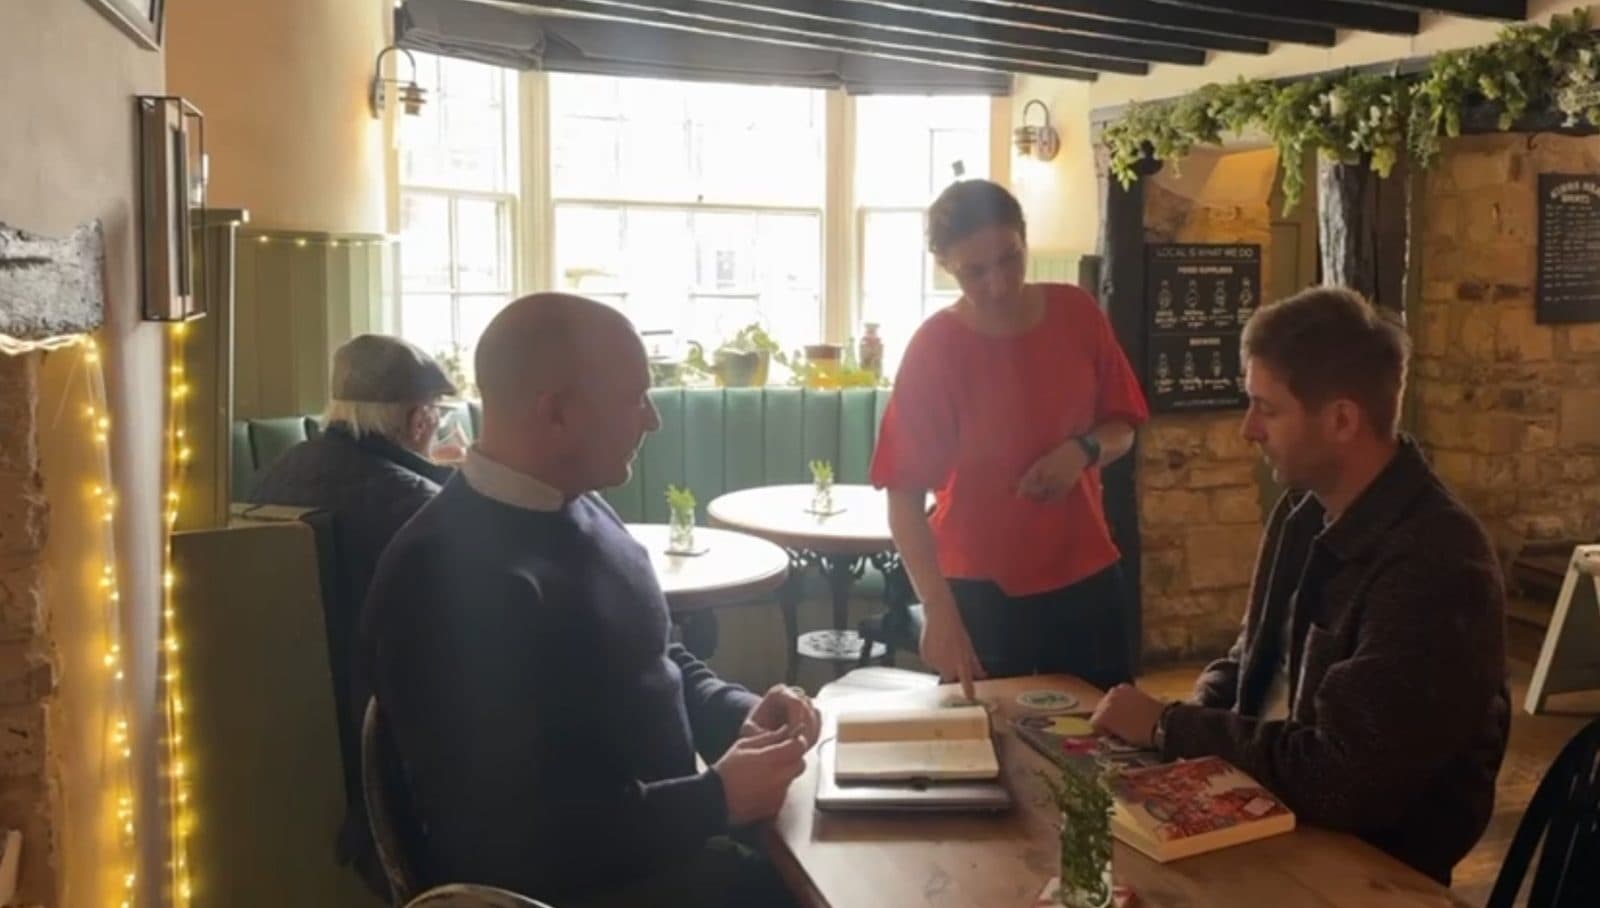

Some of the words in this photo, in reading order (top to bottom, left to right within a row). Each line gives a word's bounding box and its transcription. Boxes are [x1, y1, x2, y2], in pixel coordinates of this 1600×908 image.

[1156, 247, 1186, 257] LOCAL
[1198, 247, 1222, 257] WHAT
[1224, 247, 1237, 257] WE
[1239, 247, 1254, 257] DO
